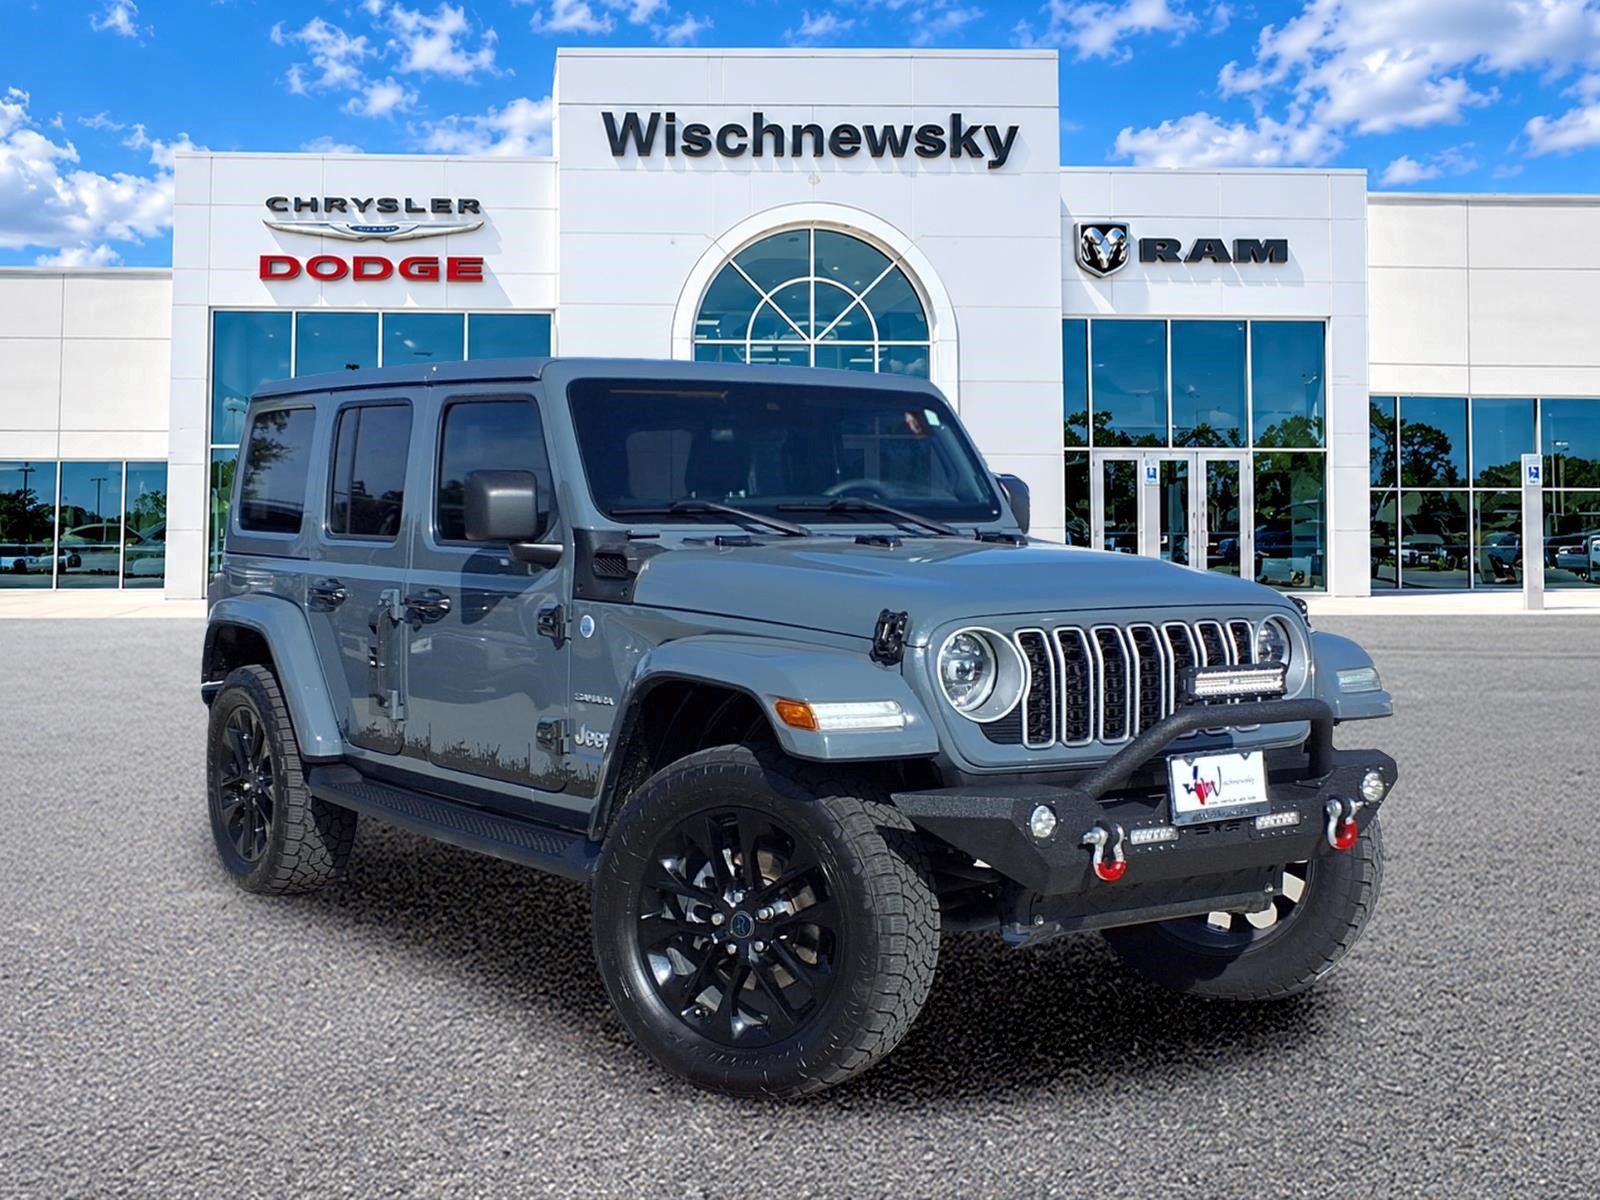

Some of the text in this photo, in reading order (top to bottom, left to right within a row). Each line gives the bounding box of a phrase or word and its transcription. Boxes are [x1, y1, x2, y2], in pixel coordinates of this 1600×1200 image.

[601, 111, 1020, 170] Wischnewsky
[265, 196, 481, 214] CHRYSLER
[1138, 238, 1289, 264] RAM
[259, 254, 484, 282] DODGE
